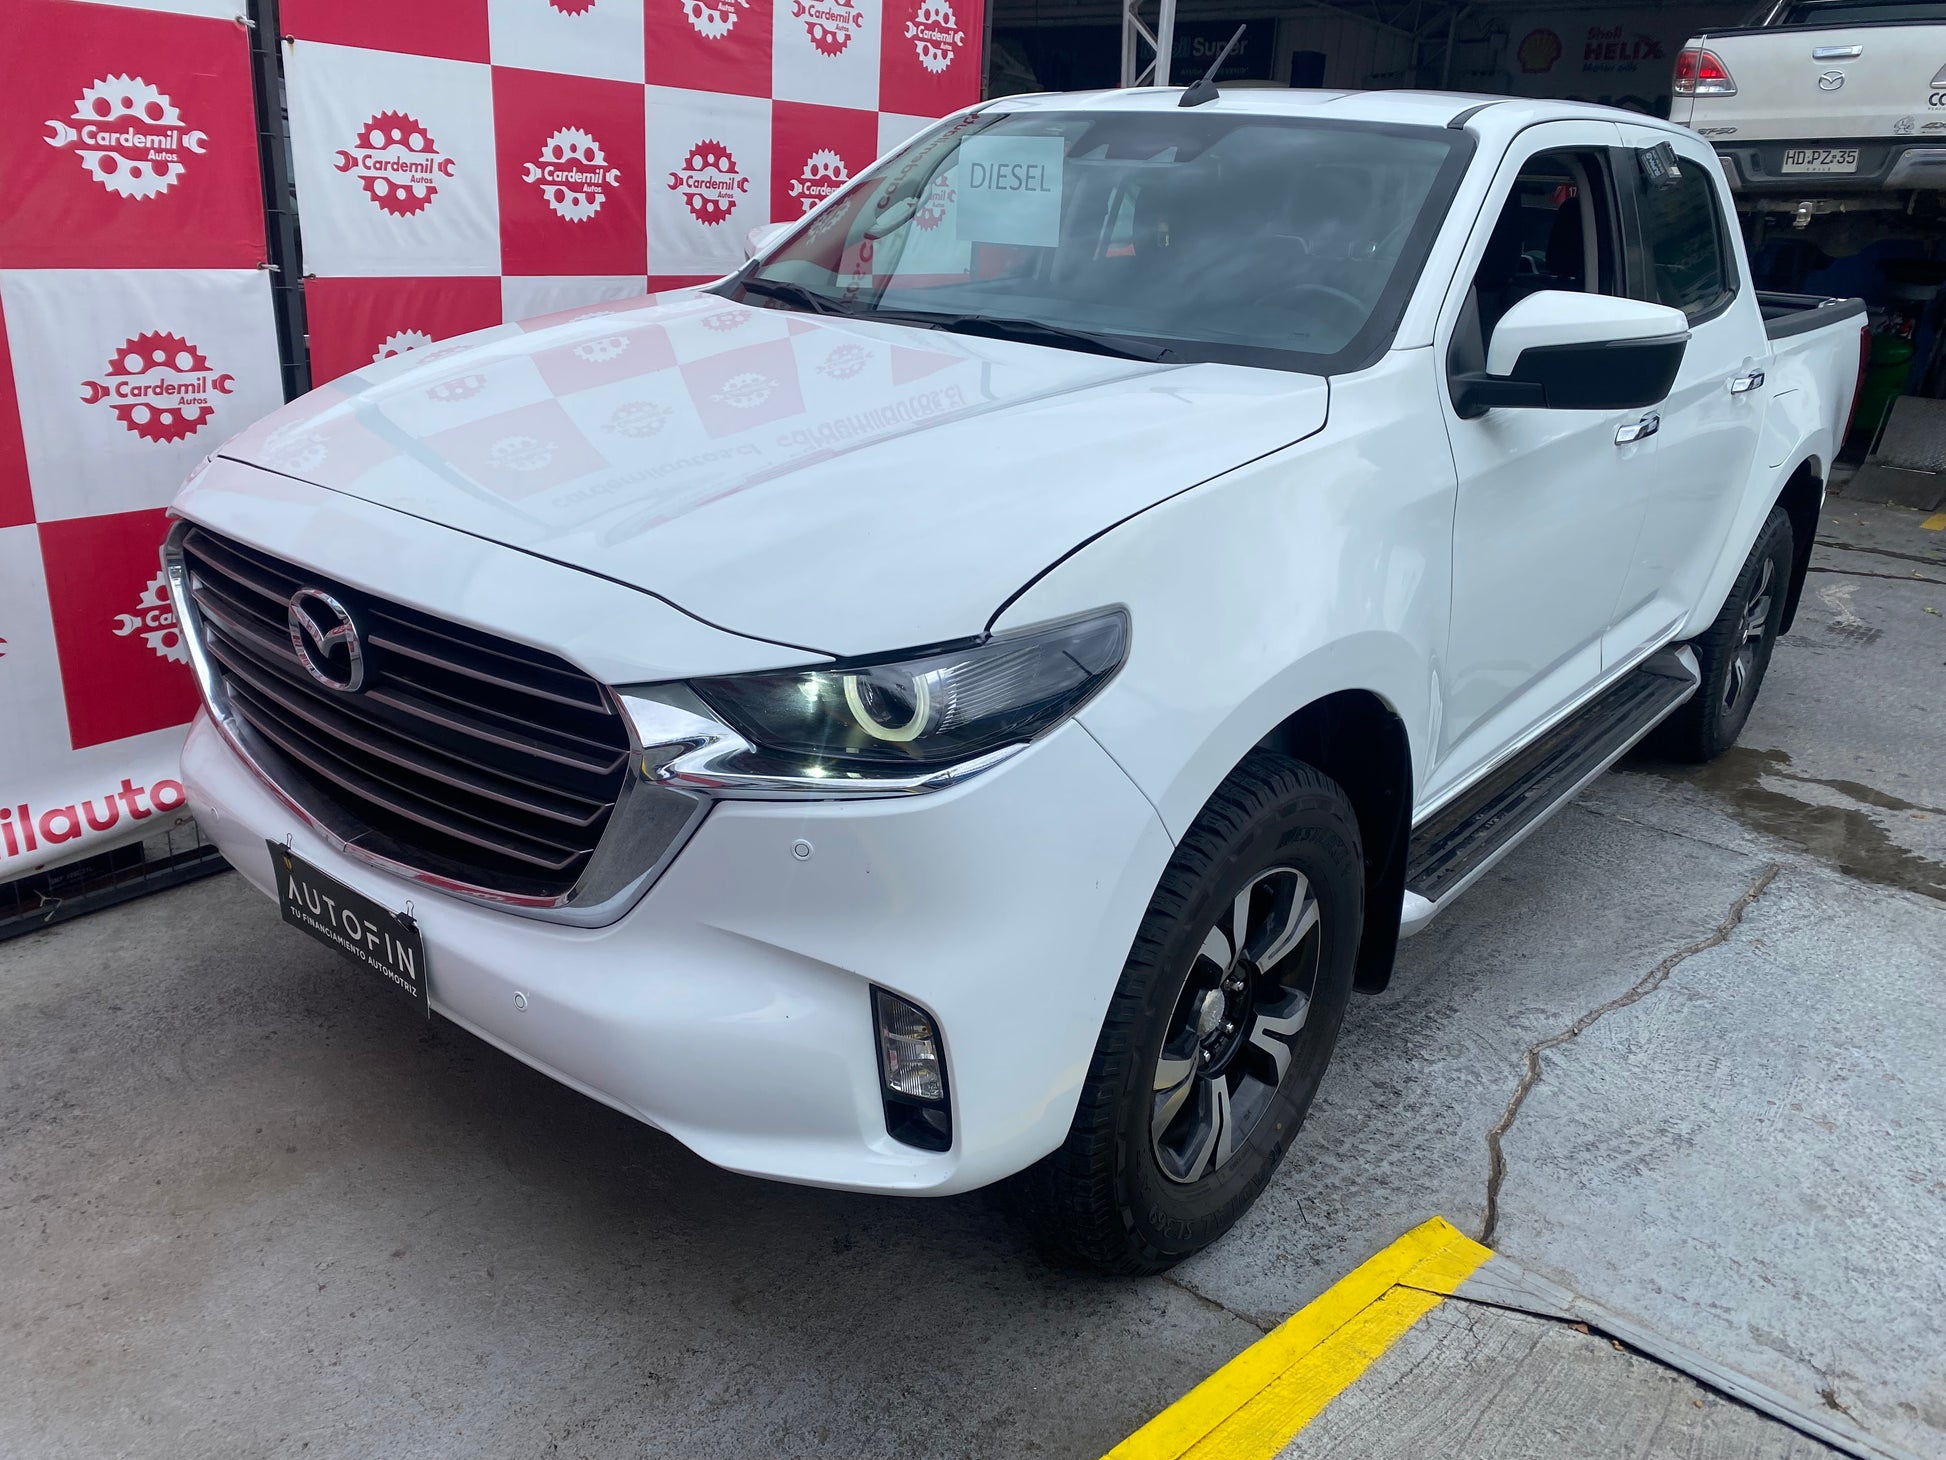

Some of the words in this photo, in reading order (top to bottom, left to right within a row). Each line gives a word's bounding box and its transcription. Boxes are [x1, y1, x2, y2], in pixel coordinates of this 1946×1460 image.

[808, 5, 850, 24] Cardemil
[918, 25, 954, 42] Cardemil
[1584, 37, 1664, 60] HELIX
[81, 125, 179, 149] Cardemil
[147, 149, 179, 162] Autos
[361, 154, 434, 175] Cardemil
[410, 175, 434, 184] Autos
[544, 165, 604, 185] Cardemil
[686, 174, 736, 192] Cardemil
[970, 162, 1051, 192] DIESEL
[582, 184, 603, 193] Autos
[717, 191, 735, 199] Autos
[804, 182, 842, 195] Carde
[115, 375, 207, 397] Cardemil
[178, 396, 208, 406] Autos
[288, 875, 416, 980] AUTOFIN
[290, 906, 301, 919] TU
[302, 913, 366, 960] FINANCIAMIENTO
[368, 956, 418, 998] AUTOMOTRIZ
